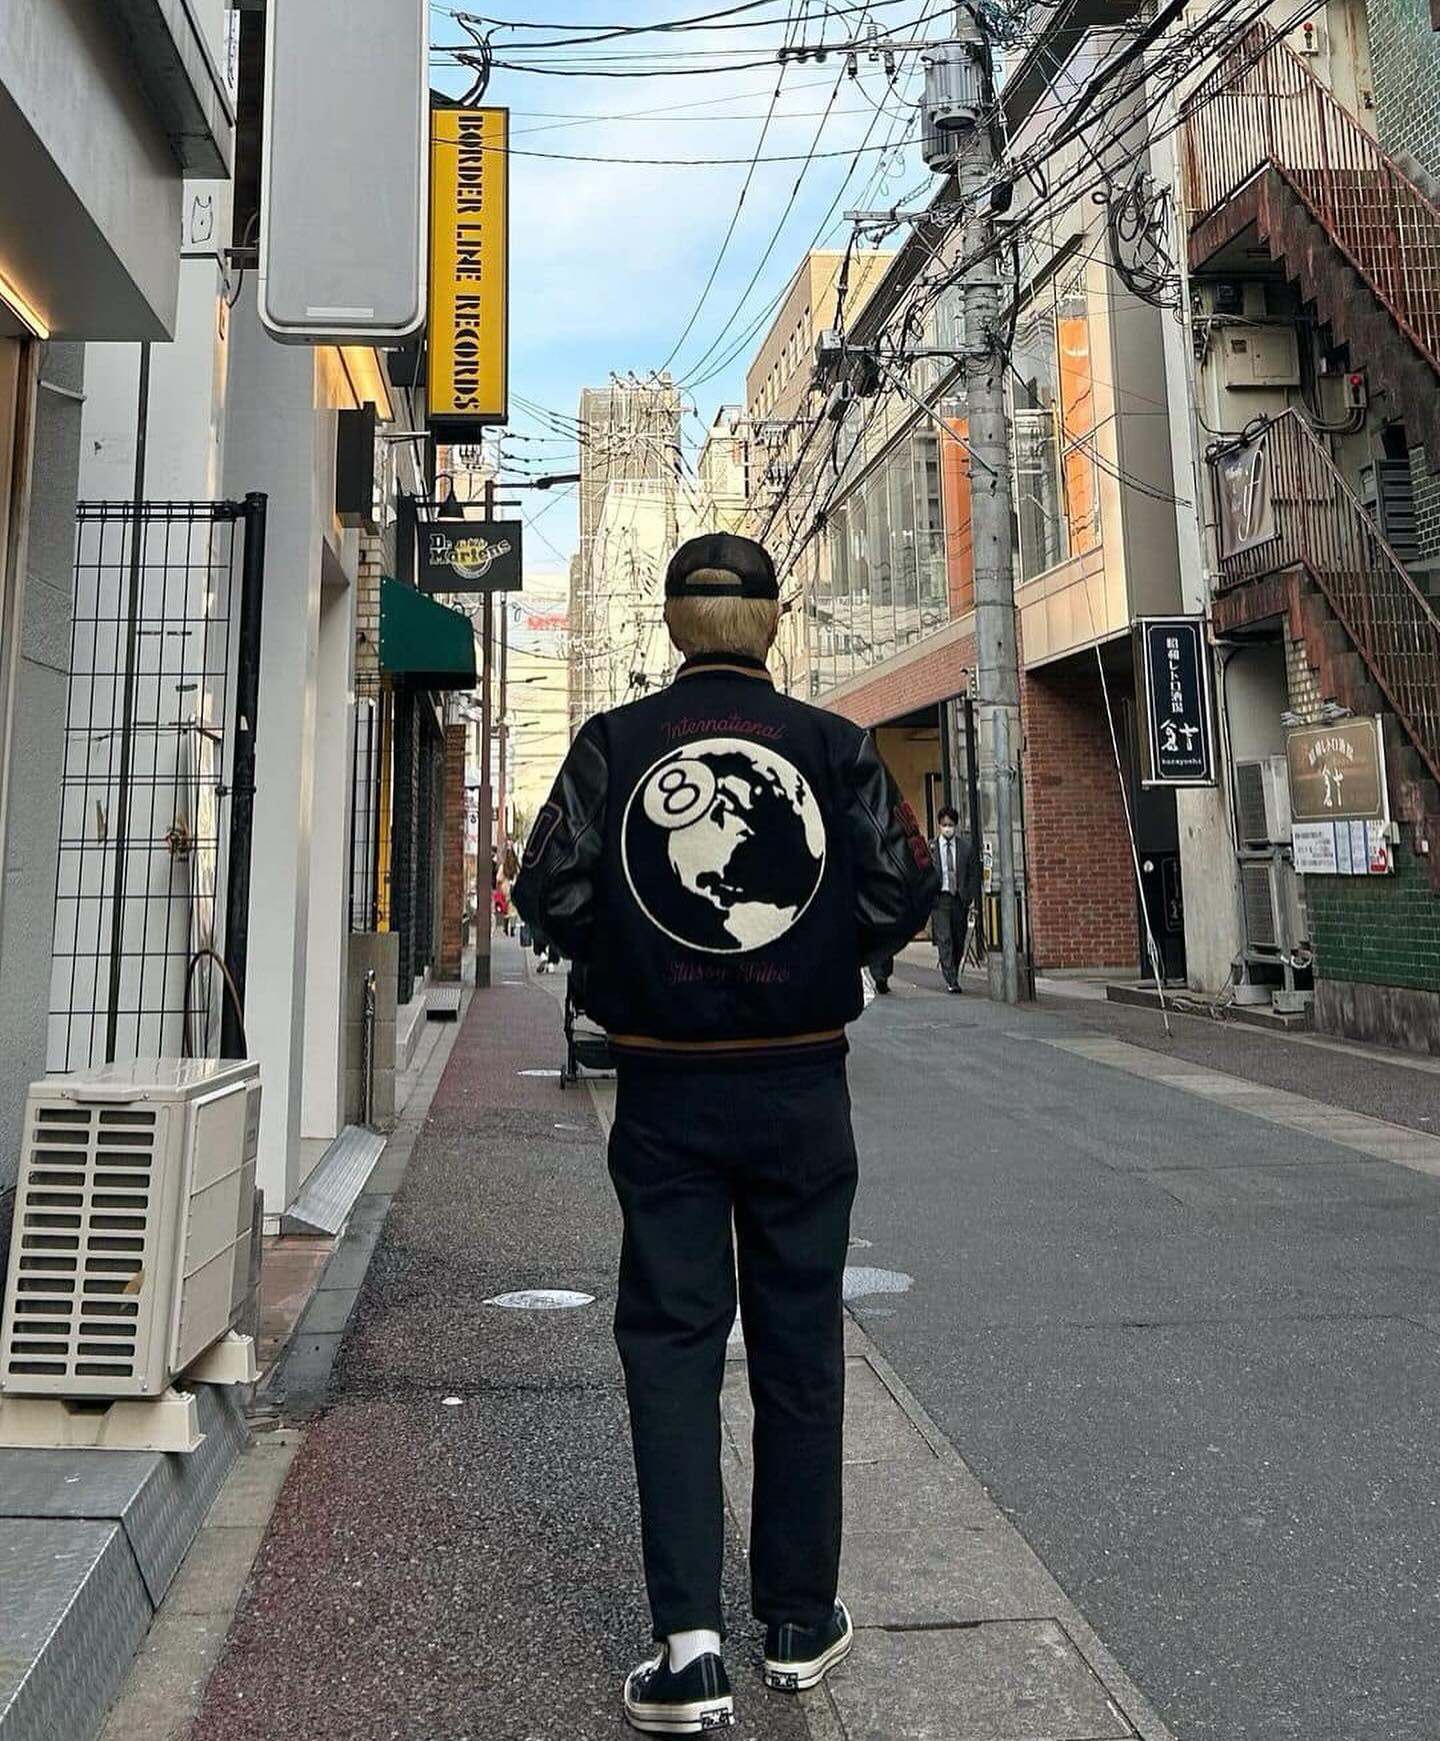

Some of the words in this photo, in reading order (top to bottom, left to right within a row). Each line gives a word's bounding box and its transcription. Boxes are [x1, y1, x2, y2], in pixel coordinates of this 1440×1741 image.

[456, 115, 483, 214] BORDER
[456, 224, 482, 282] LINE
[453, 295, 481, 411] RECORDS
[430, 538, 512, 564] Martens
[1166, 637, 1183, 713] 昭和レトロ酒場
[660, 711, 784, 741] International
[659, 769, 700, 814] 8
